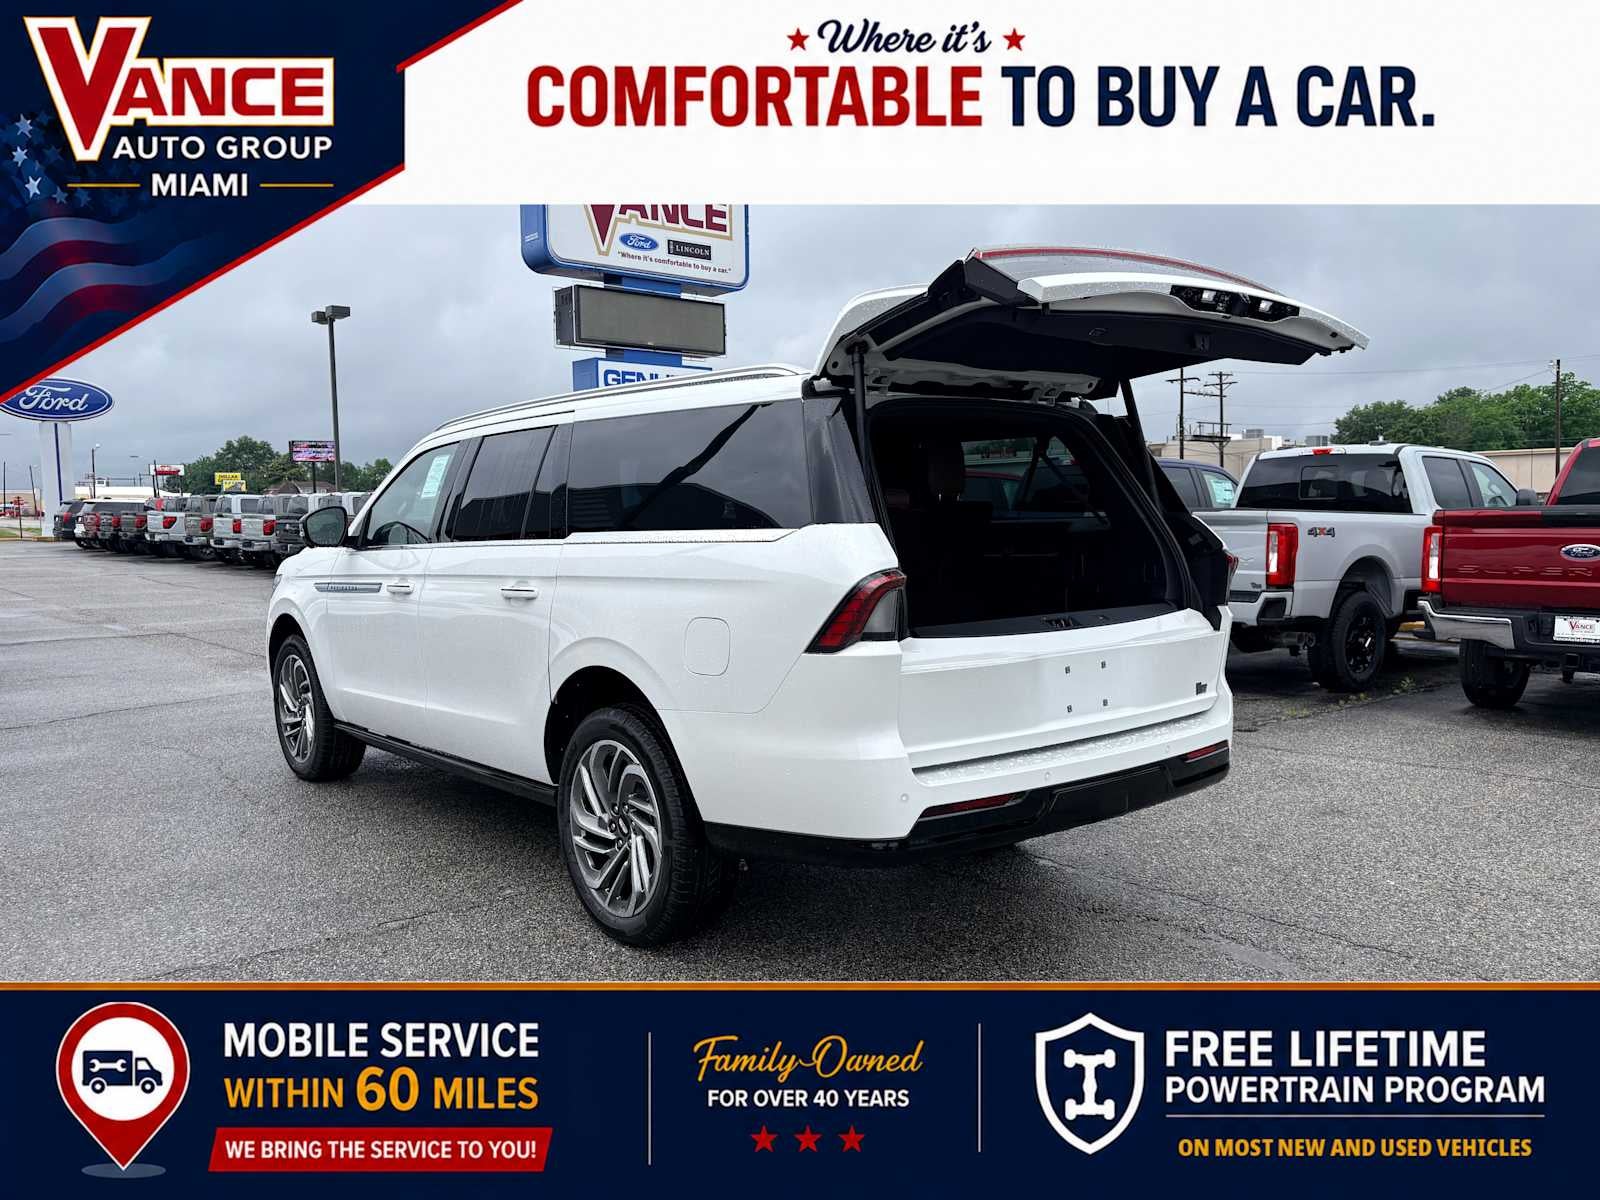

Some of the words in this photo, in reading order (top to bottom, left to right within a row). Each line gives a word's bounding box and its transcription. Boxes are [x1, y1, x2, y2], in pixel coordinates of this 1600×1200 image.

[627, 234, 652, 249] Ford
[675, 244, 710, 256] LINCOLN
[643, 254, 654, 263] it's
[654, 257, 692, 269] comfortable
[700, 264, 712, 273] buy
[18, 384, 89, 410] Ford
